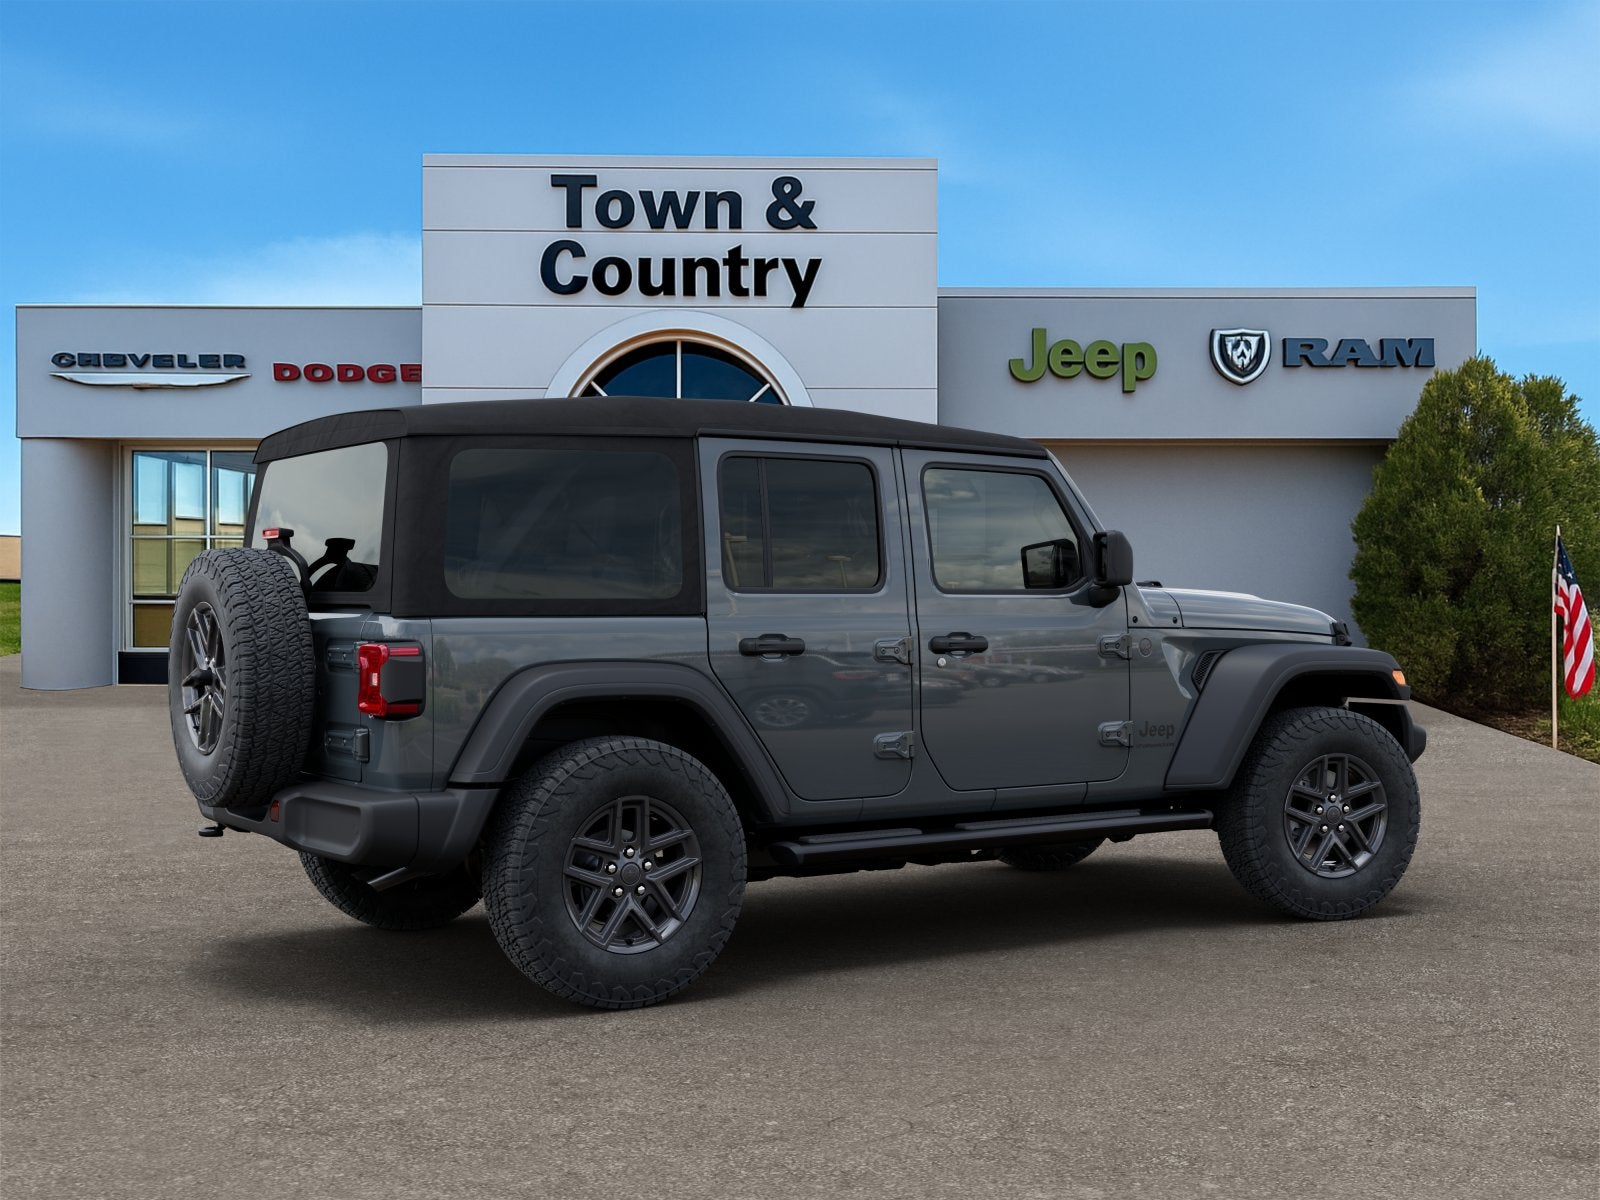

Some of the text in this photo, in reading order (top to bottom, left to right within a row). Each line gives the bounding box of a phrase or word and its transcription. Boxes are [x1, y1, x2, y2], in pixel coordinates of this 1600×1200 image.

[550, 174, 818, 230] Town &
[540, 239, 822, 308] Country
[273, 362, 422, 383] DODGE
[1008, 328, 1158, 393] Jeep
[1283, 337, 1435, 368] RAM
[1138, 720, 1175, 740] Jeep
